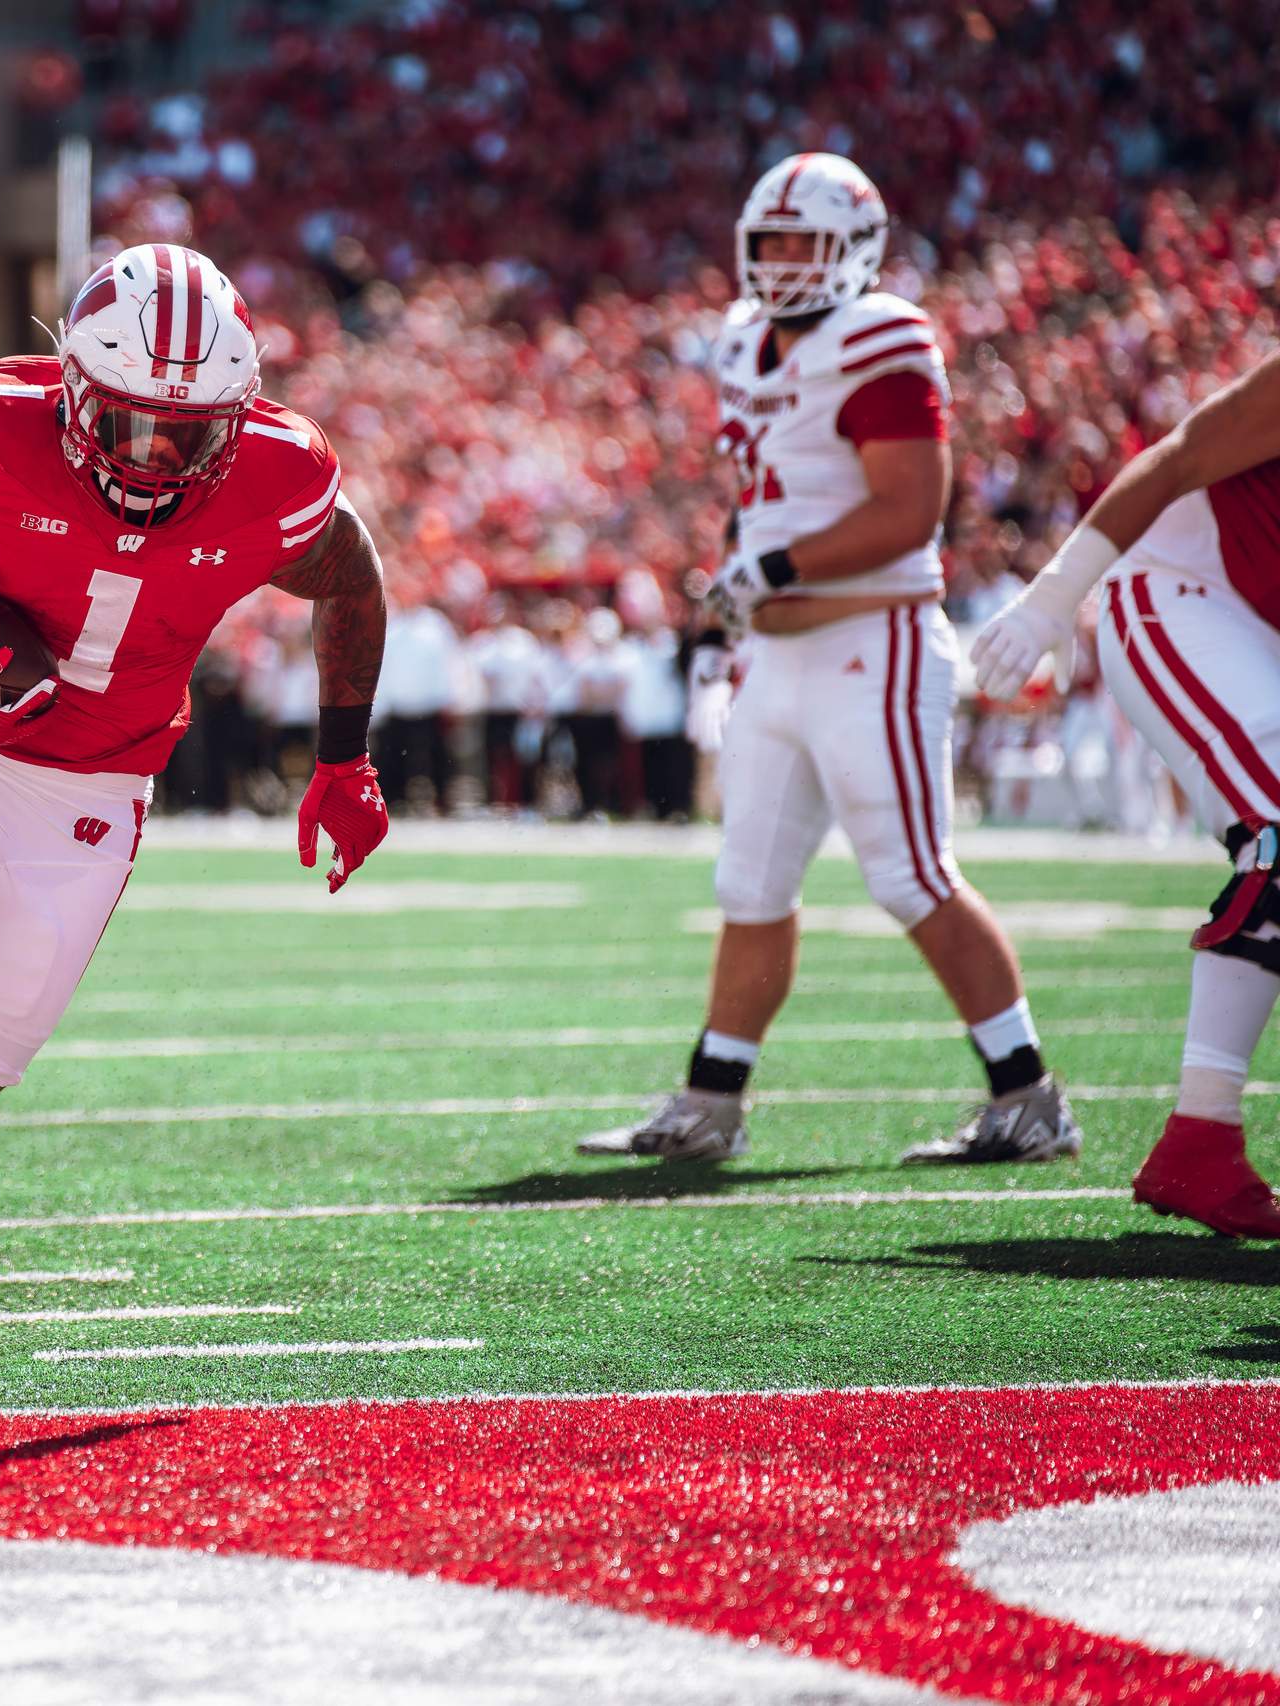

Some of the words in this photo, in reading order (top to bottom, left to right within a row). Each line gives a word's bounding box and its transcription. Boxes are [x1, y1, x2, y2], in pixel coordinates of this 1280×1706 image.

[116, 534, 146, 553] W
[58, 568, 144, 694] 1
[73, 816, 112, 847] W
